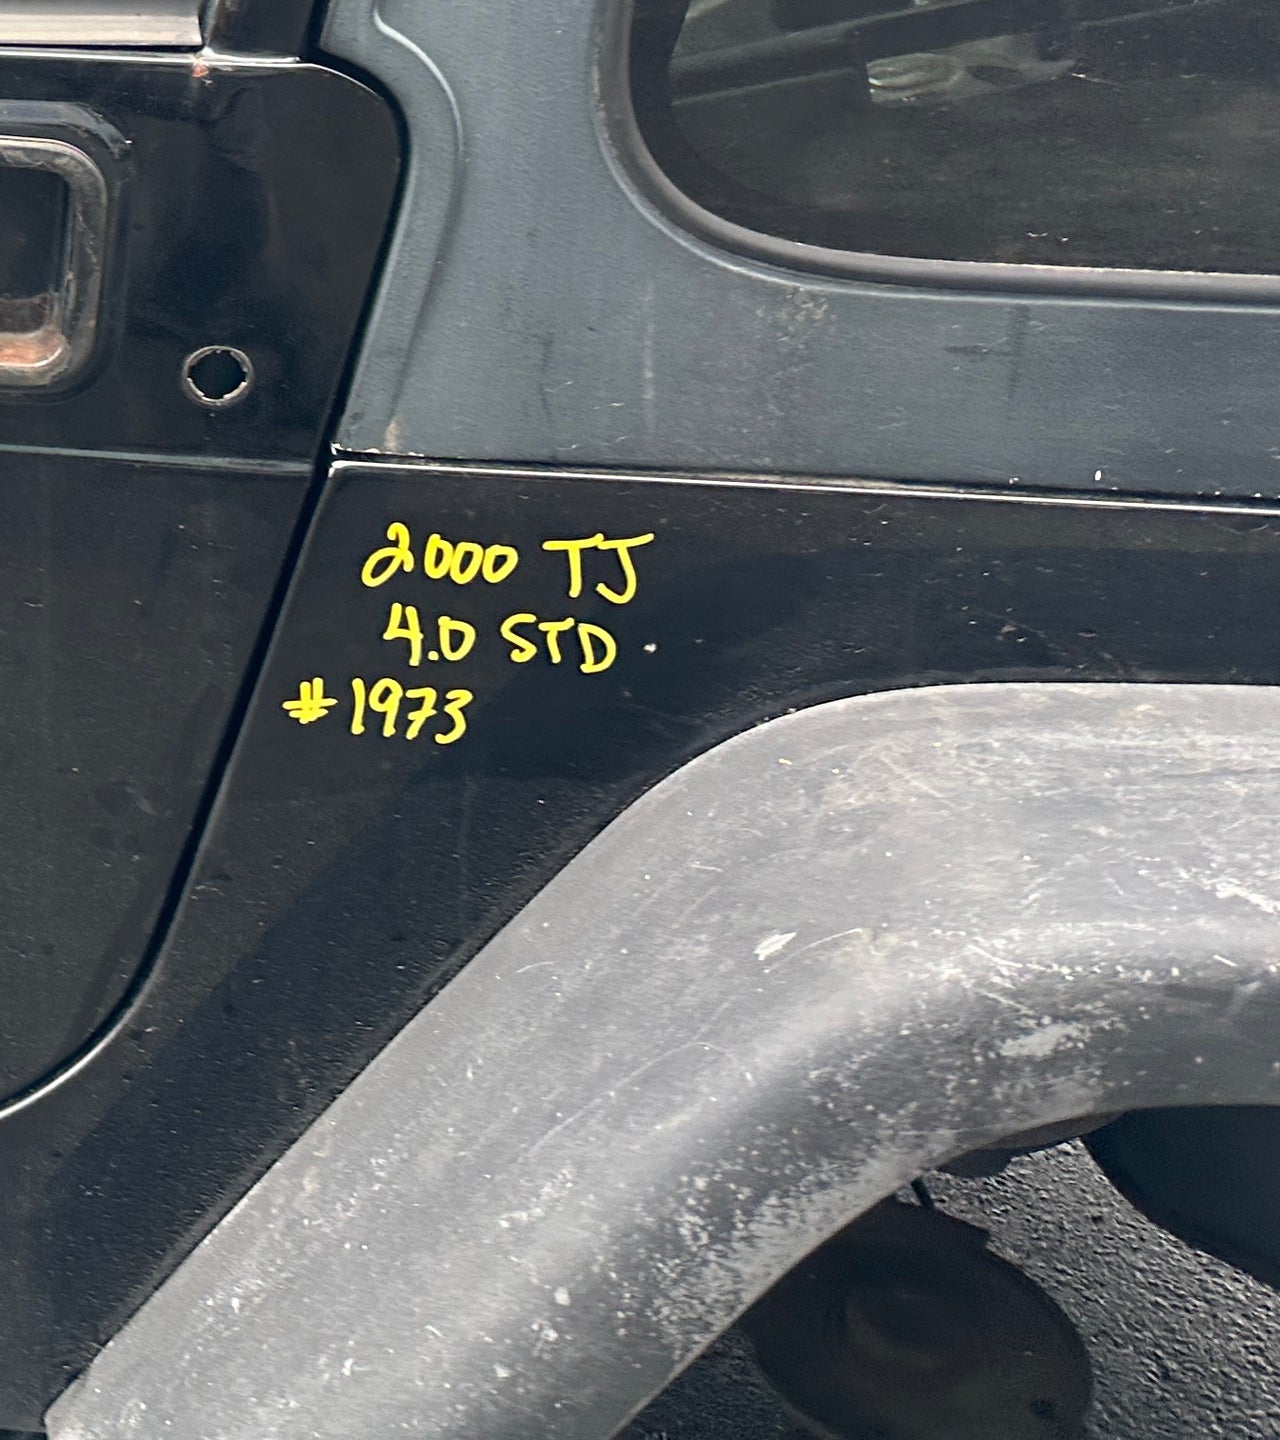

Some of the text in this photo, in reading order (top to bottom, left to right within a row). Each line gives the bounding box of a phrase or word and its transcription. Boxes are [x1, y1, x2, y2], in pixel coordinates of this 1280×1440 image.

[361, 521, 654, 605] 2000 TJ
[382, 602, 617, 674] 4.0 STD
[282, 677, 474, 746] #1973
